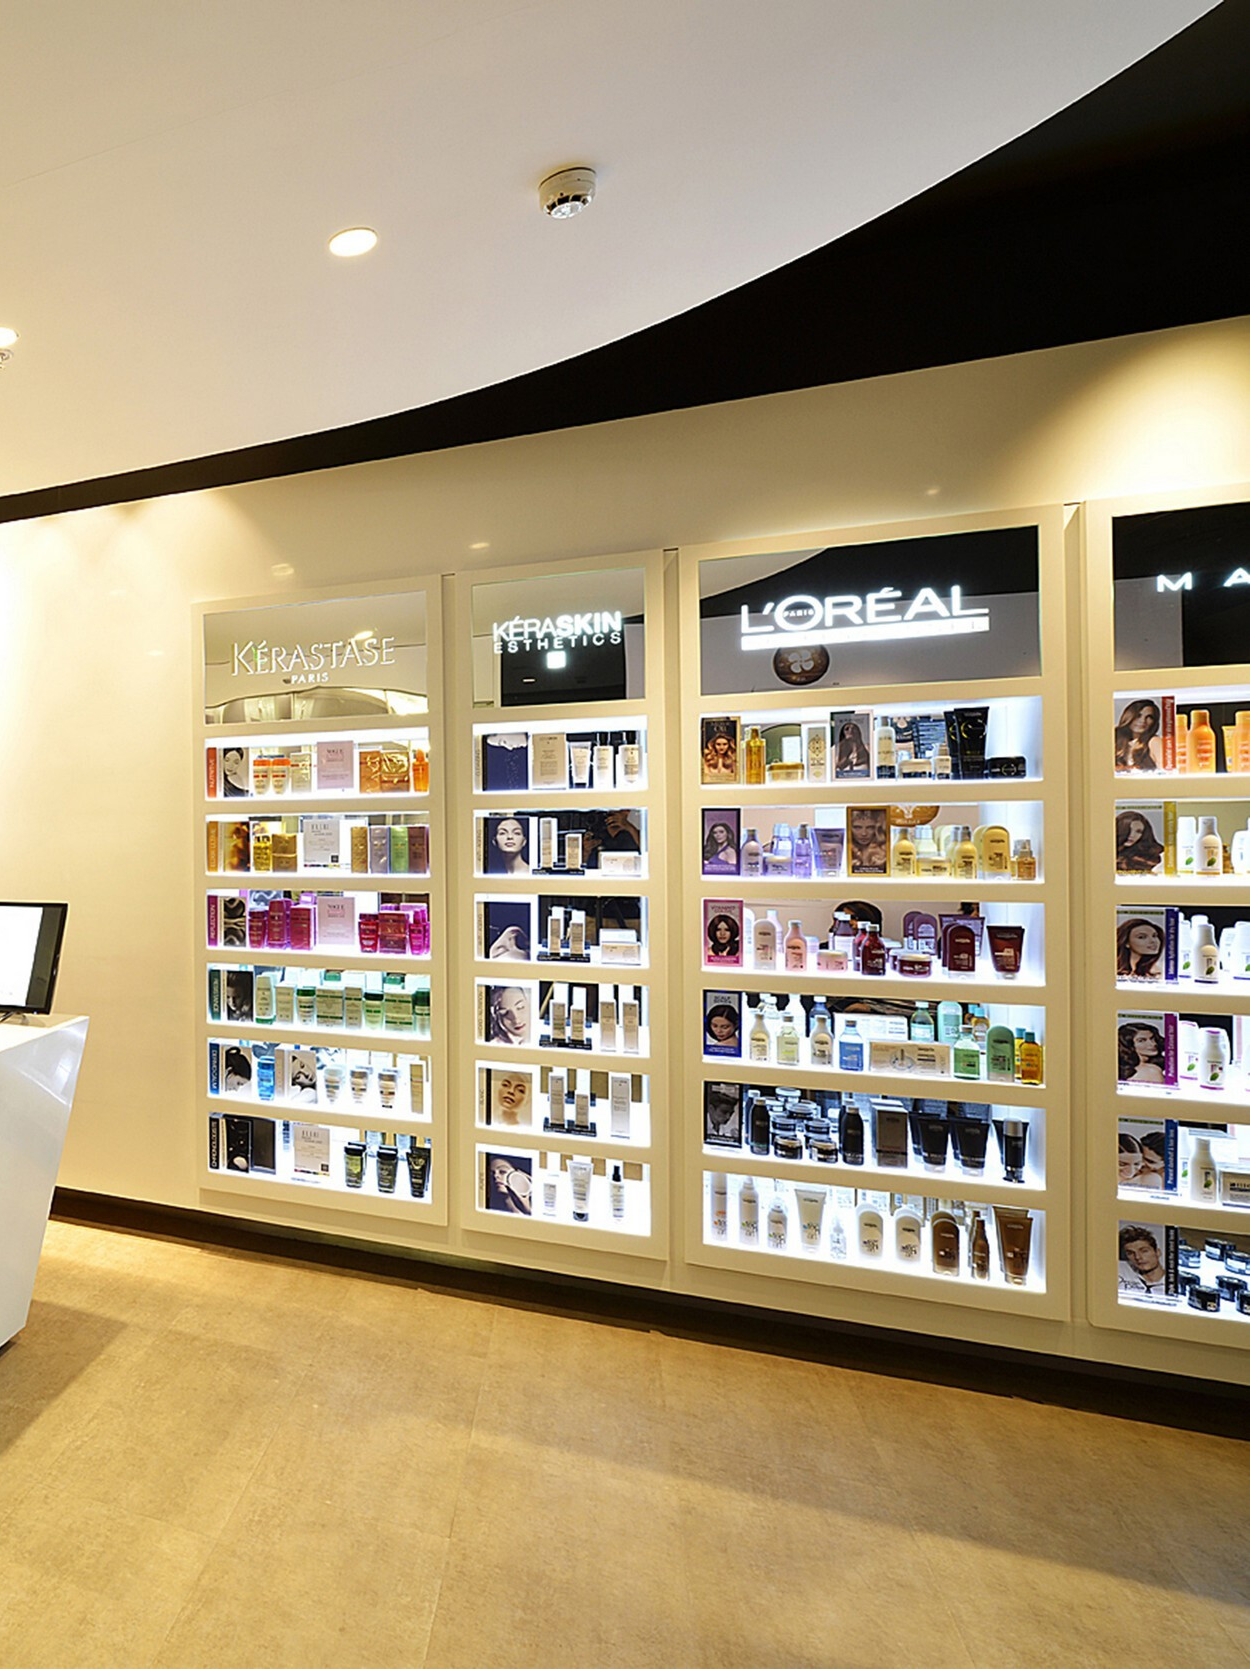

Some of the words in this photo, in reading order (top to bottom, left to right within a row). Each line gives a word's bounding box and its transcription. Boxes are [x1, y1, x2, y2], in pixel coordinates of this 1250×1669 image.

[741, 584, 989, 633] L'ORÉAL
[492, 610, 622, 642] KÉRASKIN
[232, 636, 396, 676] KÉRASTASE
[493, 632, 622, 654] ESTHETICS
[291, 672, 329, 684] PARIS
